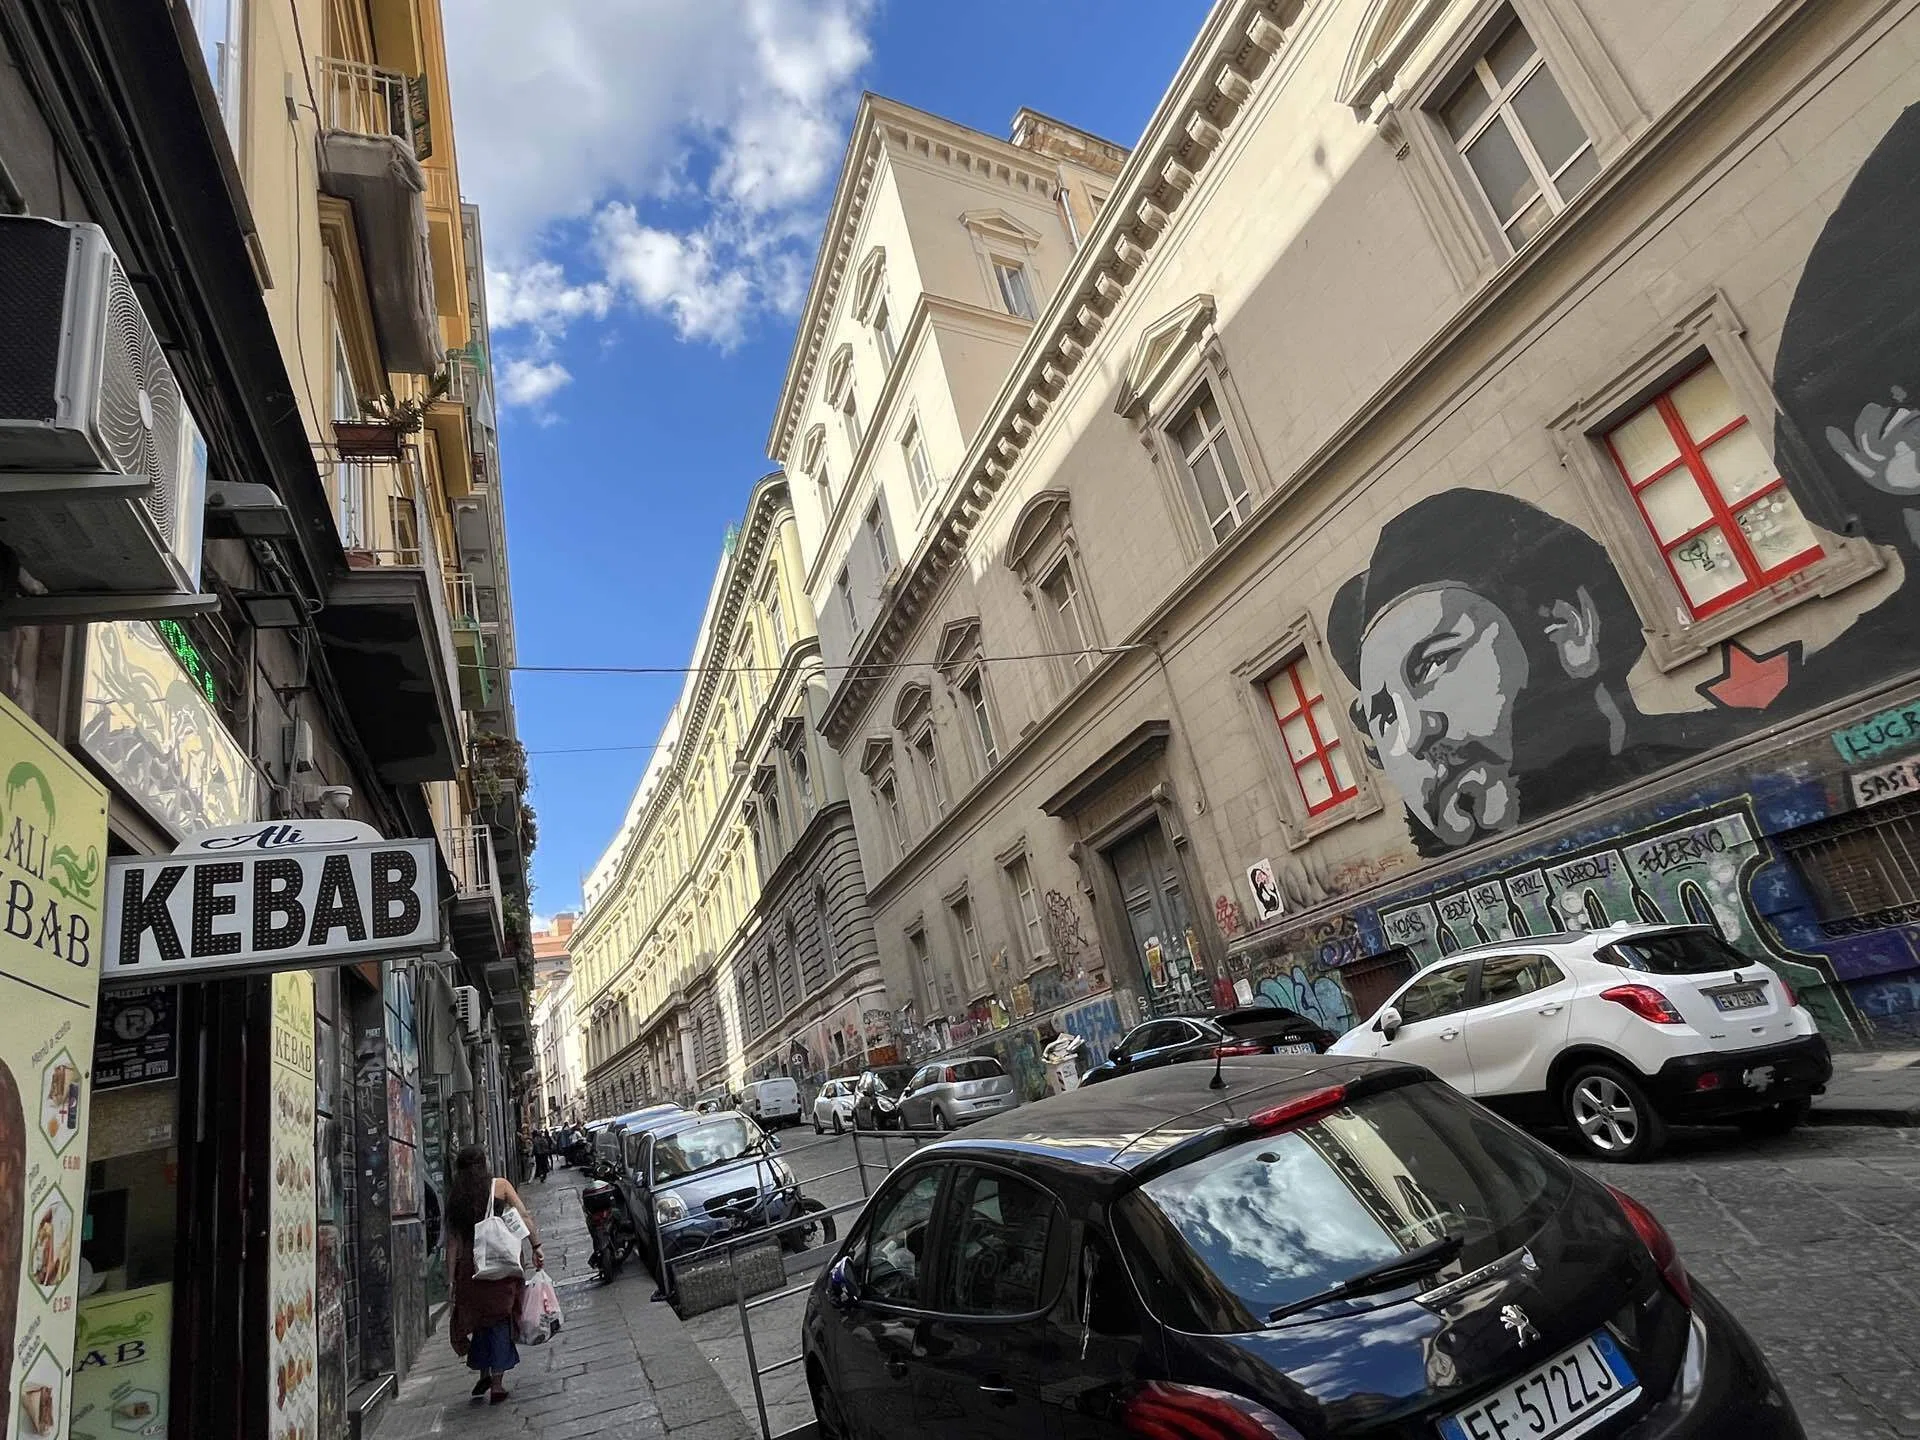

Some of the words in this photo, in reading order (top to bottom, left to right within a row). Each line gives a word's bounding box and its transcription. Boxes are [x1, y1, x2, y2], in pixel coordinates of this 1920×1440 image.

[4, 816, 48, 880] ALI
[200, 825, 357, 849] Ali
[0, 871, 90, 968] BAB
[118, 850, 422, 966] KEBAB
[275, 1026, 312, 1073] KEBAB
